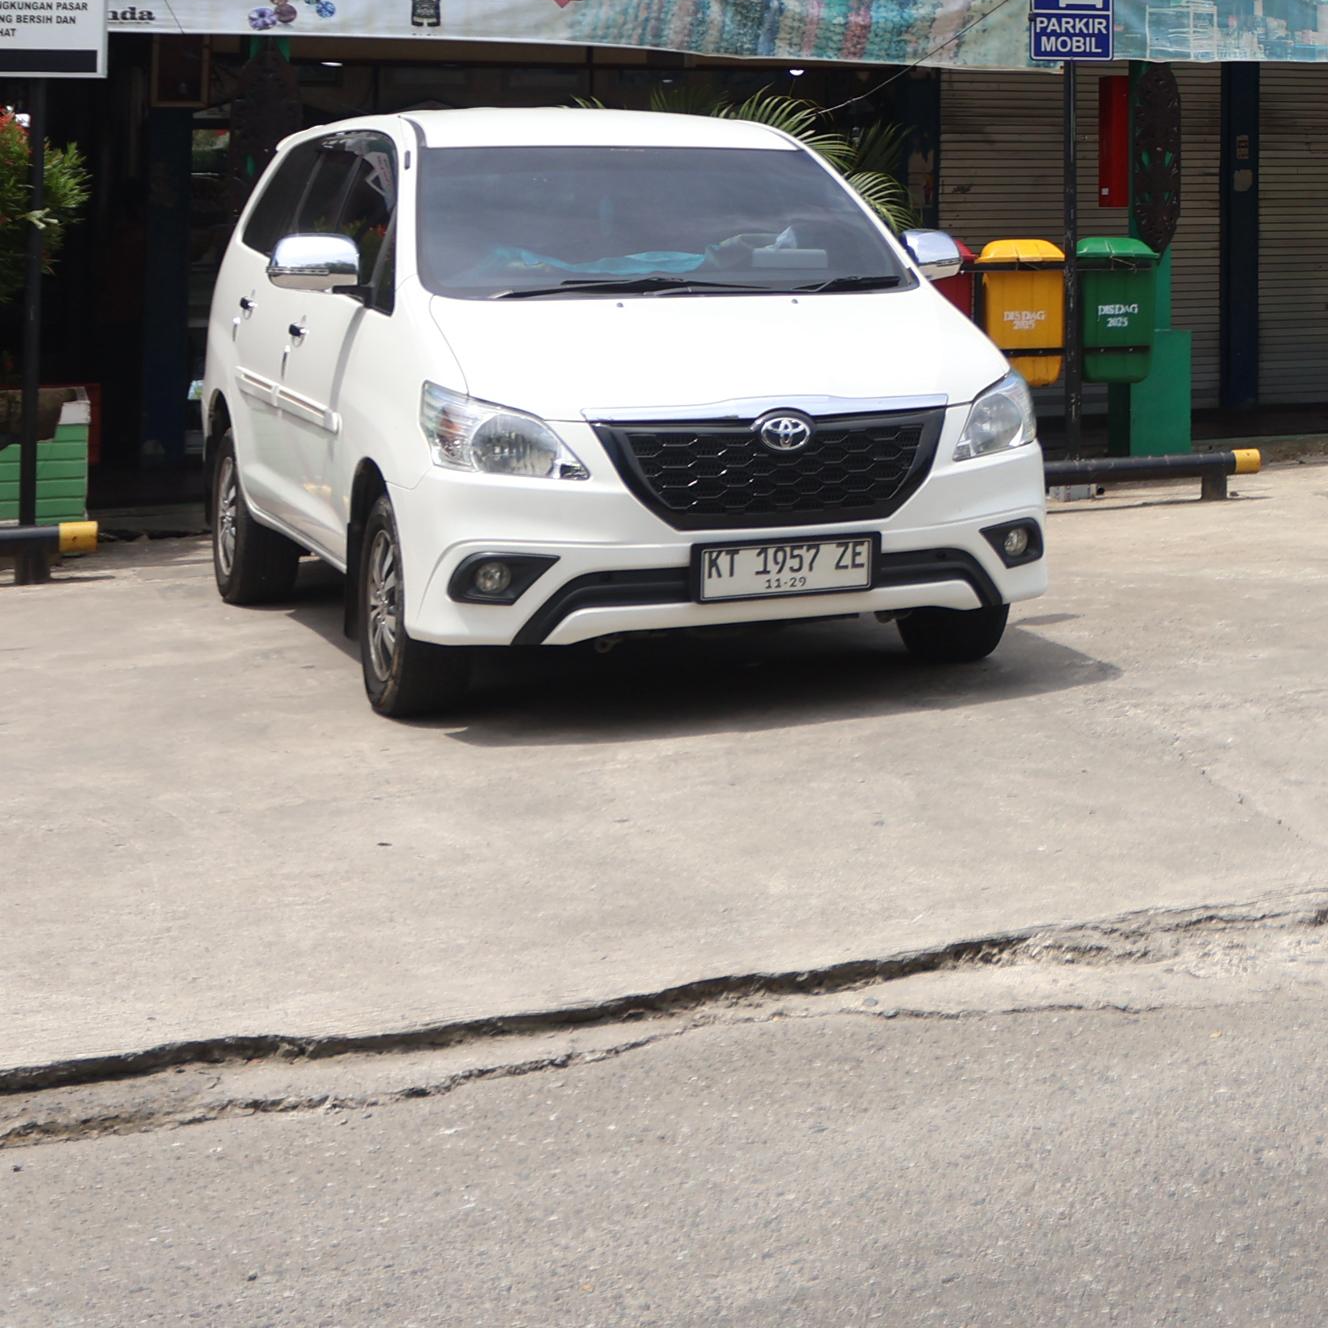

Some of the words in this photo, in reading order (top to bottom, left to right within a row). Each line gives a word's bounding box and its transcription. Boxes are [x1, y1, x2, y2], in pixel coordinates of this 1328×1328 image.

[0, 1, 53, 11] GKUNGAN
[56, 2, 88, 11] PASAR
[16, 14, 53, 24] BERSIH
[56, 15, 76, 24] DAN
[1036, 17, 1107, 34] PARKIR
[1041, 36, 1102, 53] MOBIL
[707, 549, 739, 579] KT
[755, 544, 820, 576] 1957
[835, 541, 866, 570] ZE
[765, 576, 807, 589] 11-29
